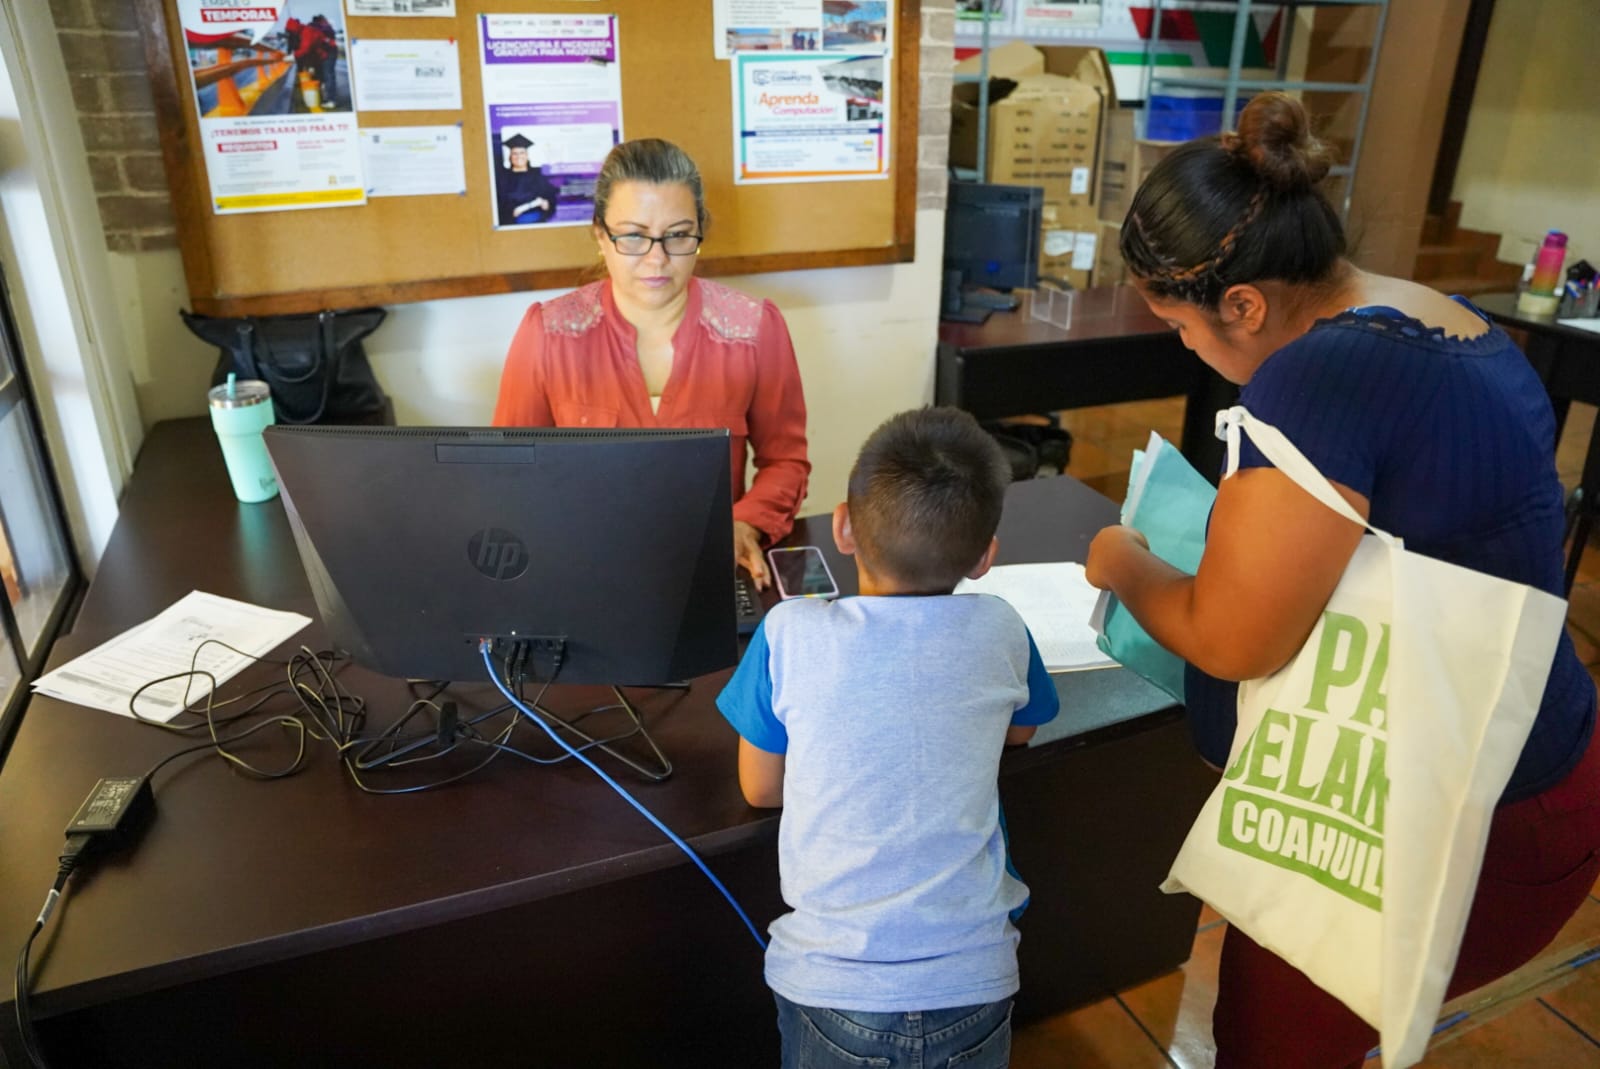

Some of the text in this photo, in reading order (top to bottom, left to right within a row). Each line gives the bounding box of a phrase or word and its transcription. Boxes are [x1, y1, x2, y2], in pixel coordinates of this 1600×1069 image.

[204, 9, 276, 21] TEMPORAL
[487, 40, 553, 50] LICENCIATURA
[493, 47, 608, 57] GRATUITA PARA MUJERES
[264, 126, 308, 135] TRABAJO
[309, 124, 334, 133] PARA
[477, 528, 522, 580] hp
